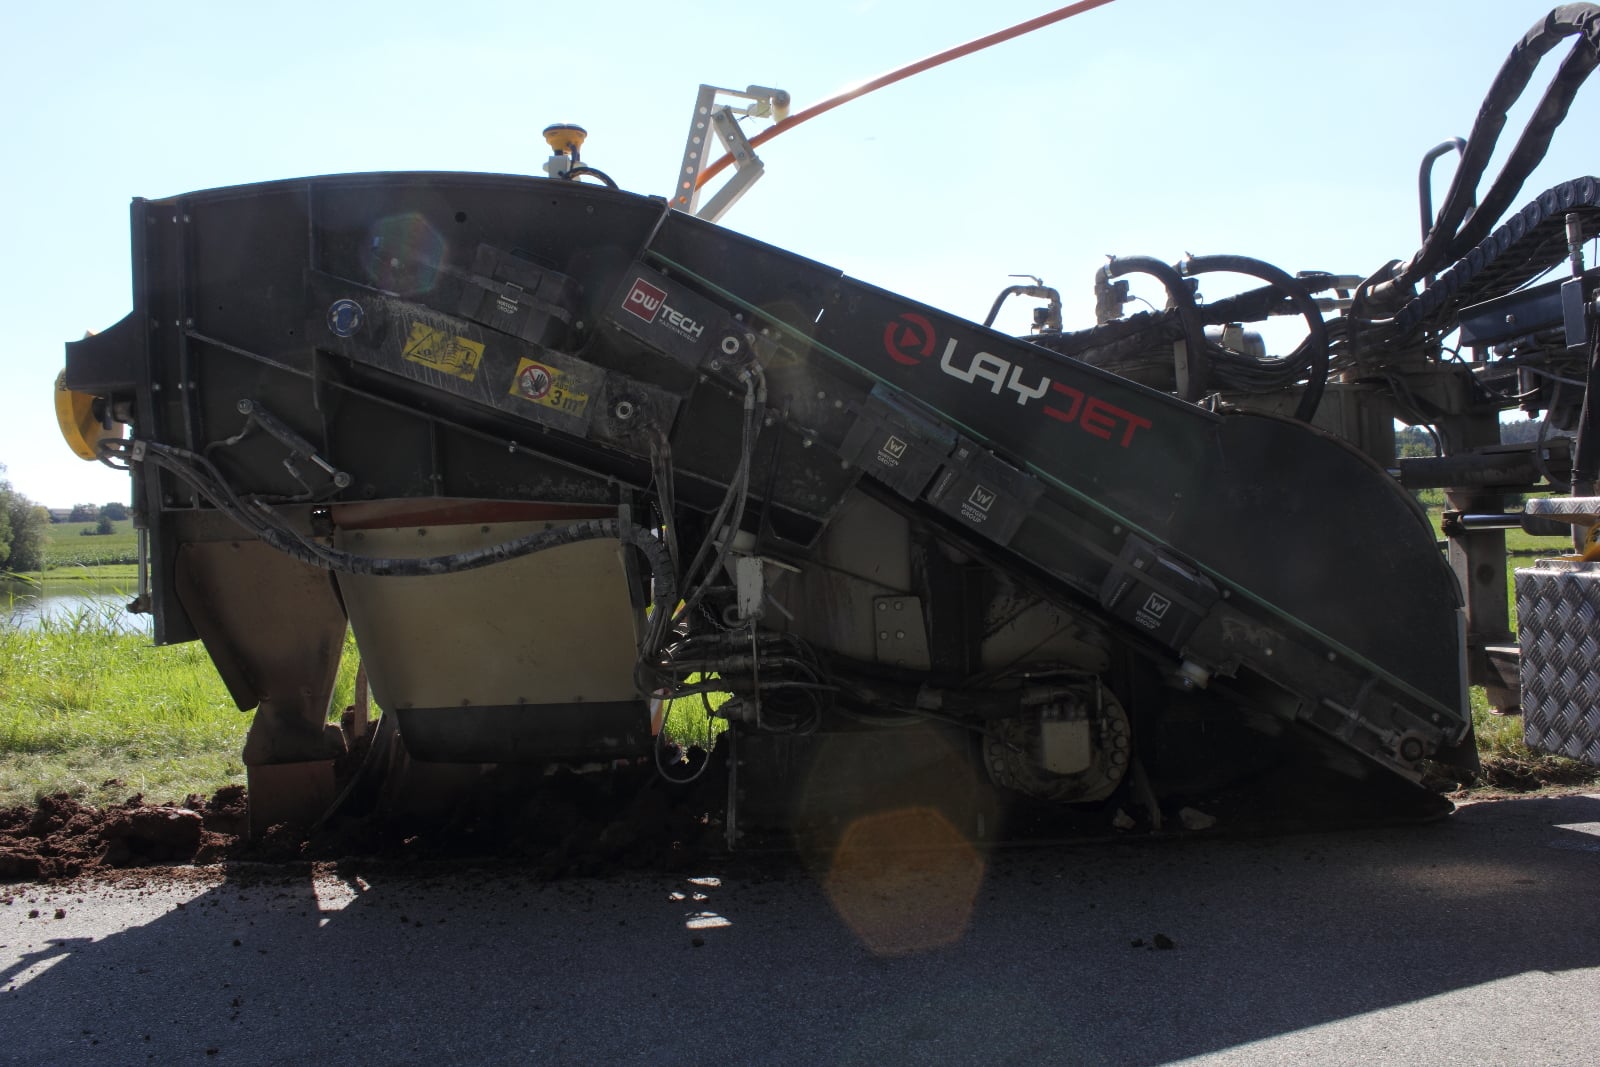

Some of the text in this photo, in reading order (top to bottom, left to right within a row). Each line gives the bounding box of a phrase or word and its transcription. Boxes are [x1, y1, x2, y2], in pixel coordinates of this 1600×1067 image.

[630, 288, 660, 311] DW
[661, 303, 705, 338] TECH
[550, 389, 563, 406] 3
[960, 509, 982, 523] GROUP
[961, 502, 987, 521] WIRTGEN
